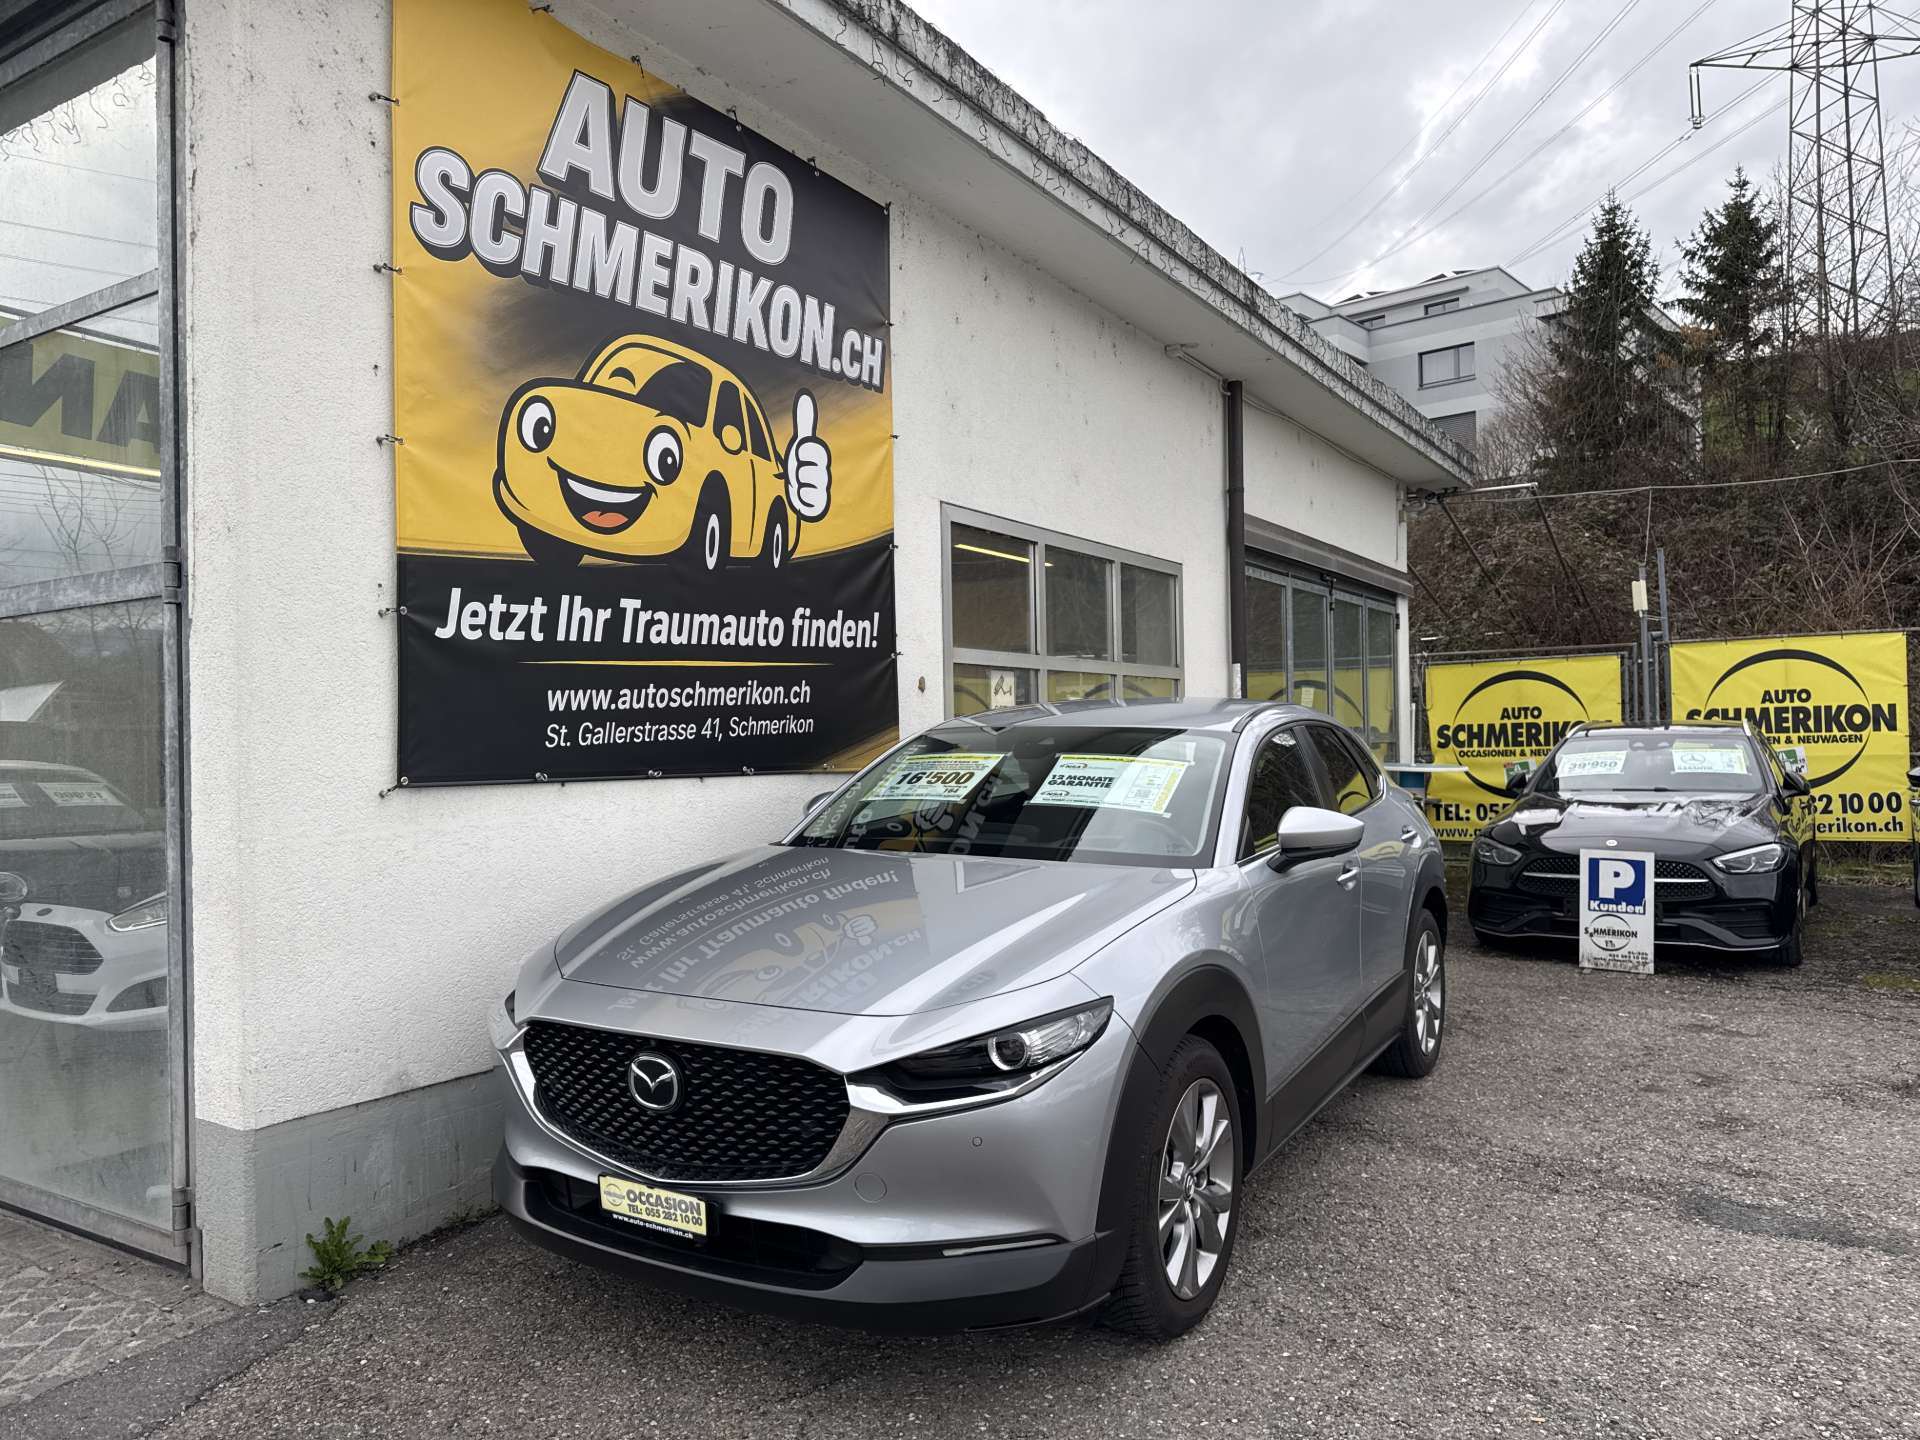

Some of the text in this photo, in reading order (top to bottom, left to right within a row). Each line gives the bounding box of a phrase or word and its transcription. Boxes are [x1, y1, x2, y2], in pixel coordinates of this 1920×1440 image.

[538, 70, 795, 267] AUTO
[411, 147, 885, 388] SCHMERIKON.CH
[434, 587, 880, 649] Jetzt Ihr Traumauto finden!
[547, 680, 811, 712] www.autoschmerikon.ch
[1761, 689, 1811, 704] AUTO
[1500, 706, 1542, 720] AUTO
[545, 715, 814, 748] St. Gallerstrasse 41, Schmerikon
[1784, 735, 1793, 744] &
[1797, 734, 1863, 745] NEUWAGEN
[1458, 749, 1517, 758] OCCASIONEN
[1519, 749, 1527, 757] &
[896, 771, 976, 785] 16'500
[1047, 780, 1114, 788] GARANTIE
[1066, 774, 1116, 783] MONATE
[1432, 803, 1470, 822] TEL:
[1841, 792, 1858, 814] 10
[1868, 792, 1902, 814] 00
[1817, 816, 1904, 833] erikon.ch
[1599, 859, 1635, 899] P
[1589, 899, 1646, 914] Kunden
[626, 1189, 701, 1216] OCCASION
[627, 1203, 703, 1227] TEL: 055 282 10 00
